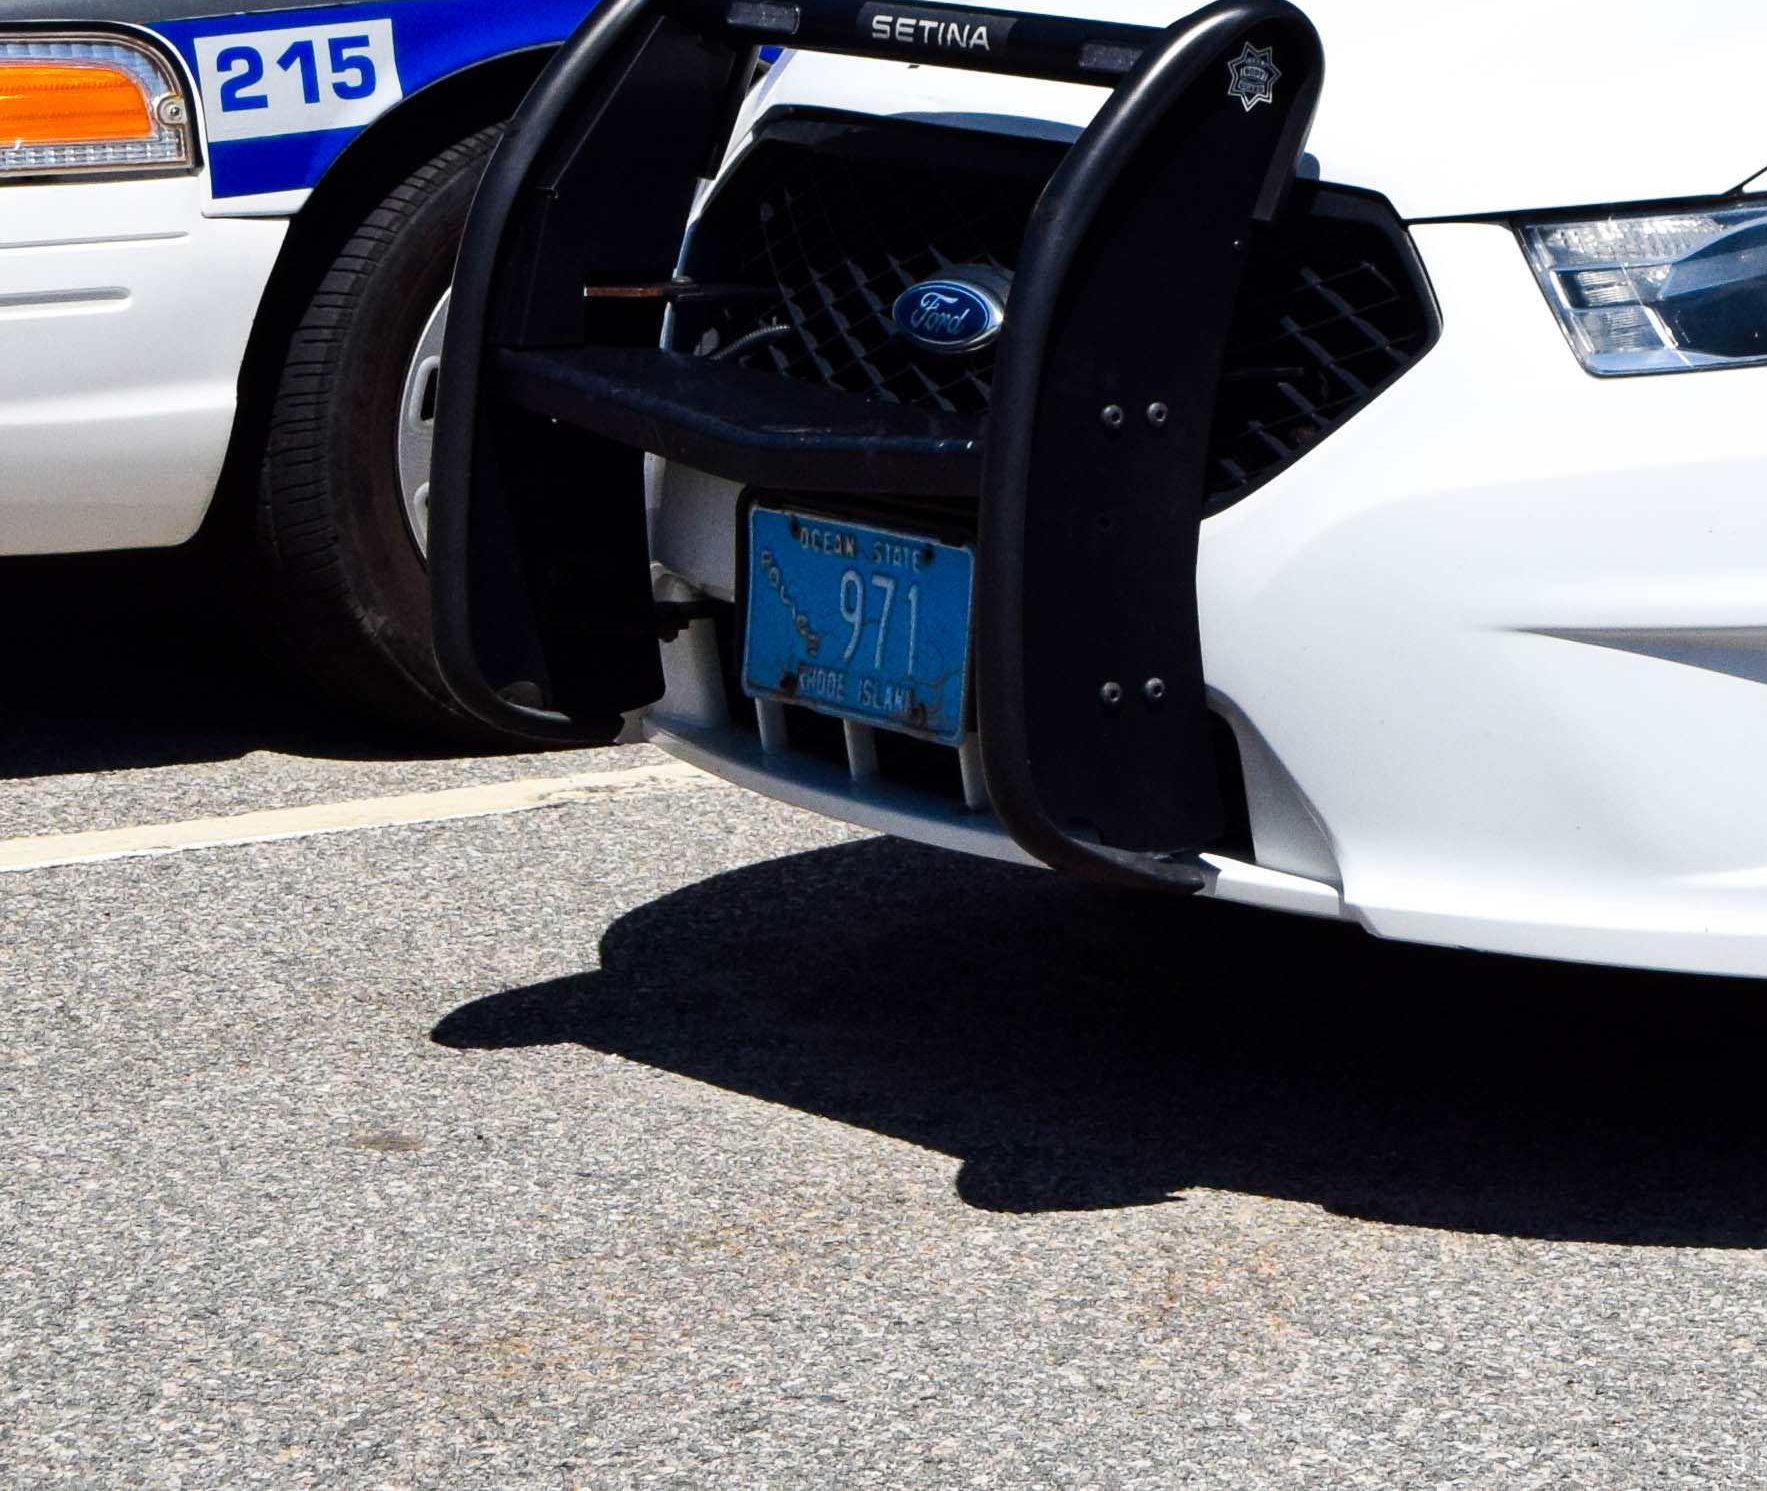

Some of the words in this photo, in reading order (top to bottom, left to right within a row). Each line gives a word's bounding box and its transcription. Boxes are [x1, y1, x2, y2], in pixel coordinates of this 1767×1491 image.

[872, 15, 990, 51] SETINA
[216, 35, 376, 112] 215
[911, 291, 970, 334] Ford
[800, 527, 855, 558] OCEAN
[873, 541, 920, 572] STATE
[840, 569, 917, 676] 971
